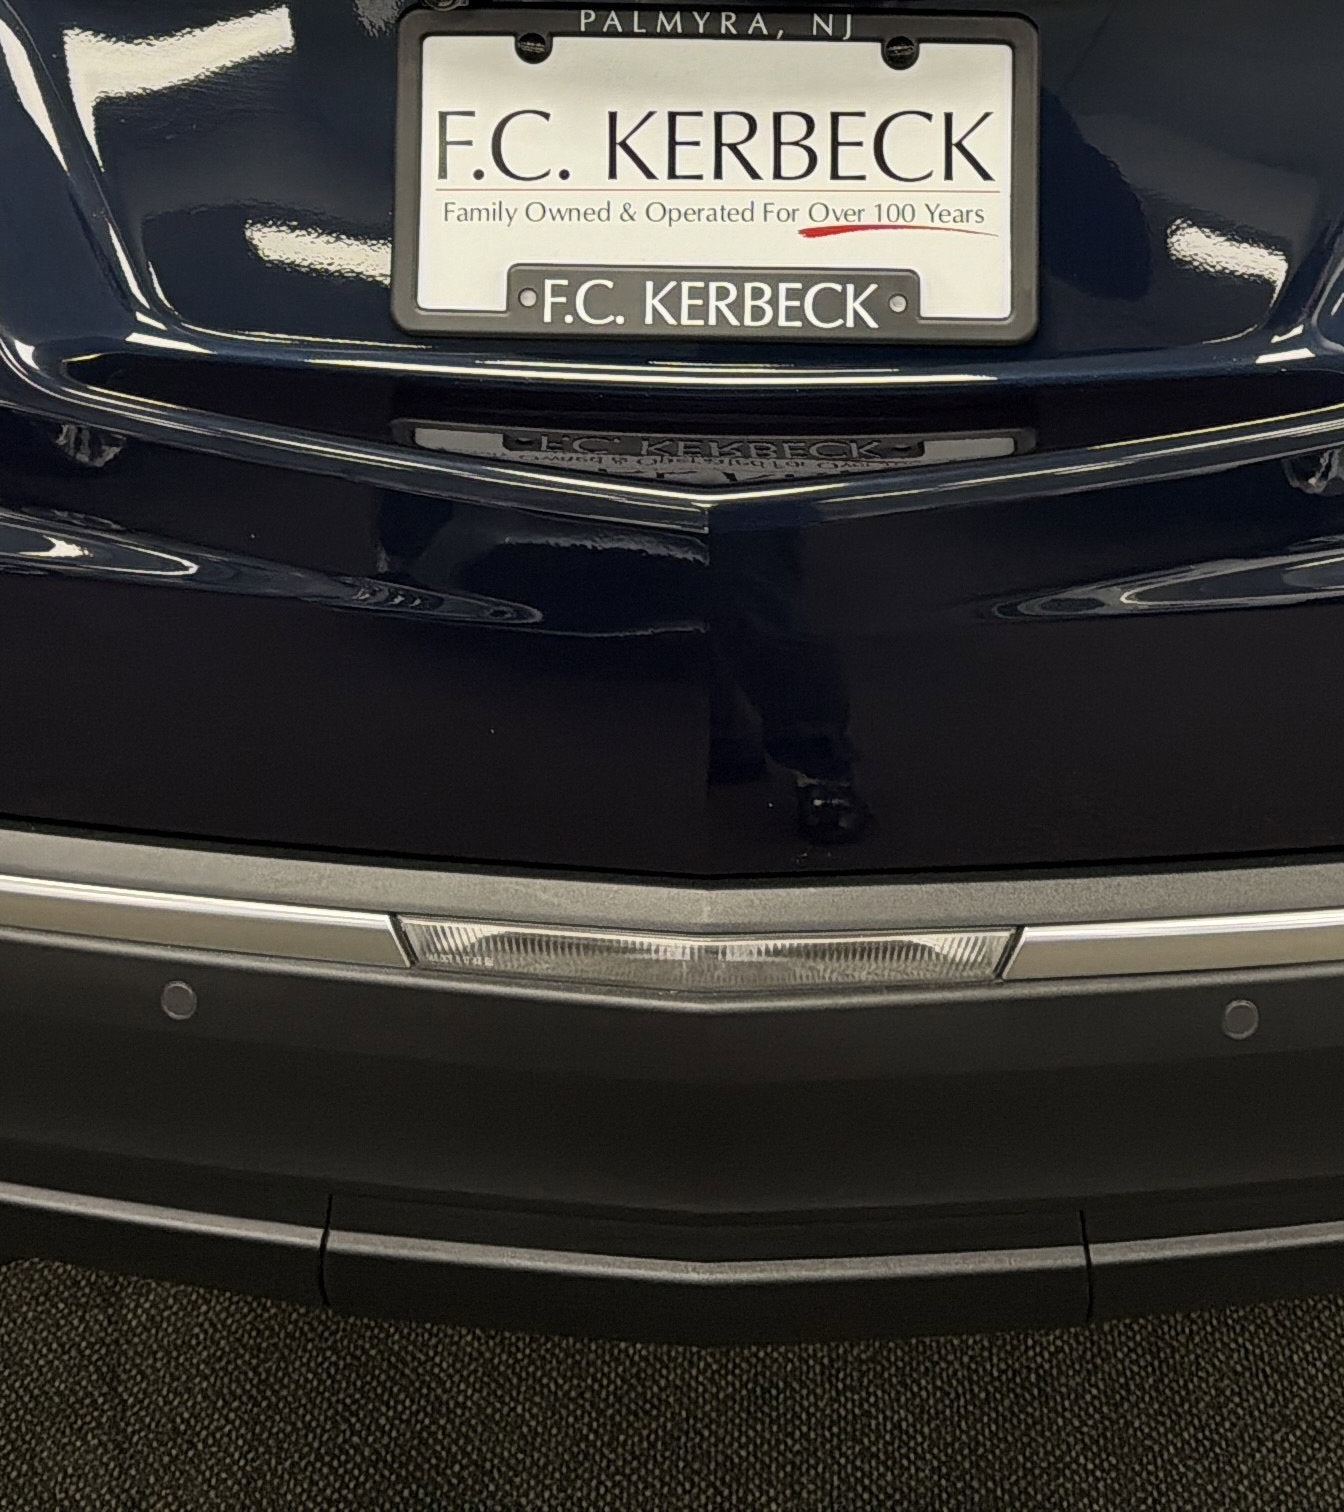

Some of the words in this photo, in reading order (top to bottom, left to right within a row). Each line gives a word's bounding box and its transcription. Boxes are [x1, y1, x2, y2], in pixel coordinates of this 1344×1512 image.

[579, 8, 785, 40] PALMYRA,
[811, 12, 855, 41] NJ
[437, 108, 571, 183] F.C.
[606, 109, 997, 184] KERBECK
[443, 200, 518, 227] Family
[525, 200, 611, 223] Owned
[619, 201, 637, 223] &
[645, 200, 755, 227] Operated
[763, 201, 800, 224] For
[808, 201, 866, 224] Over
[873, 202, 917, 224] 100
[924, 202, 985, 225] Years
[542, 278, 626, 326] F.C.
[643, 280, 880, 329] KERBECK
